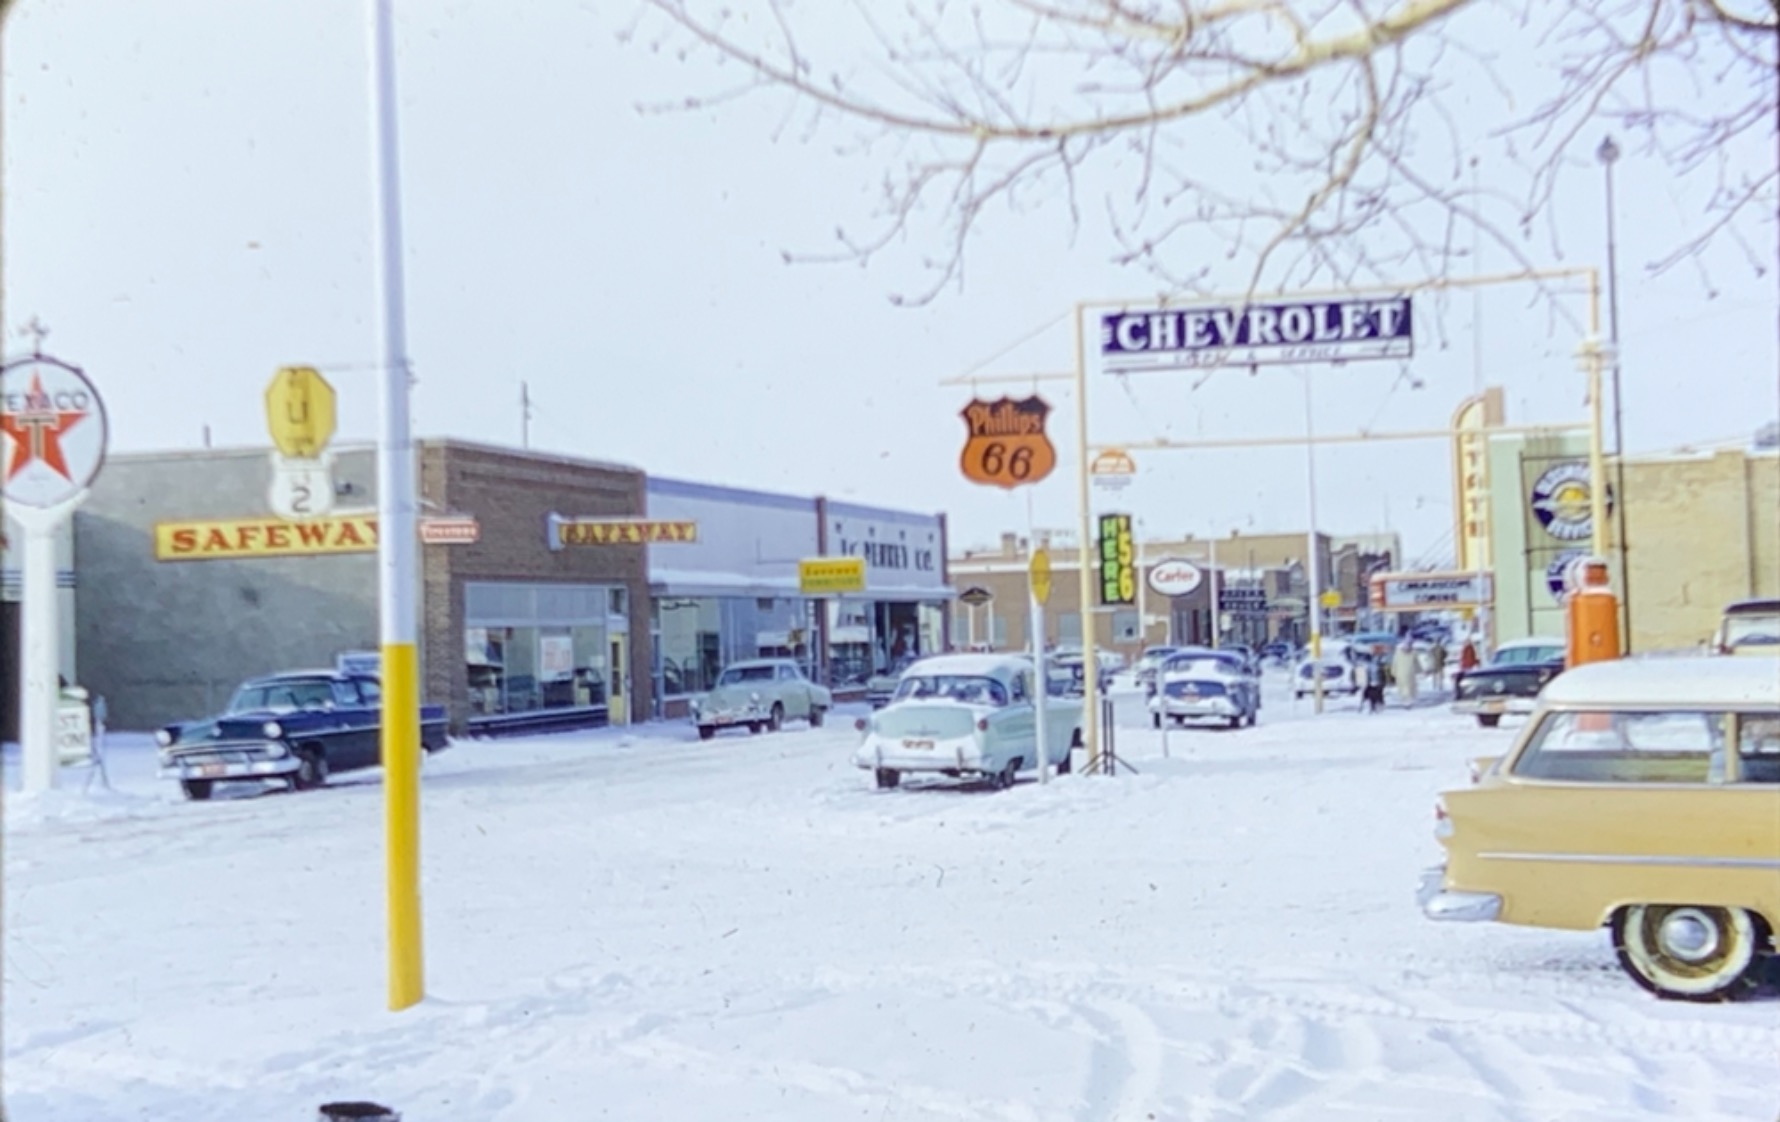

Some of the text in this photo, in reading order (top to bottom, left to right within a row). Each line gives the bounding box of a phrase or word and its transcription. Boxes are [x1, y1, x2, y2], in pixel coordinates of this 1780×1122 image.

[1116, 303, 1405, 350] CHEVROLET
[1, 390, 89, 412] EXACO
[967, 404, 1042, 436] Phillips
[981, 442, 1035, 481] 66
[291, 485, 312, 513] 2
[564, 522, 695, 545] SAFEWAY
[1103, 518, 1119, 602] HERE
